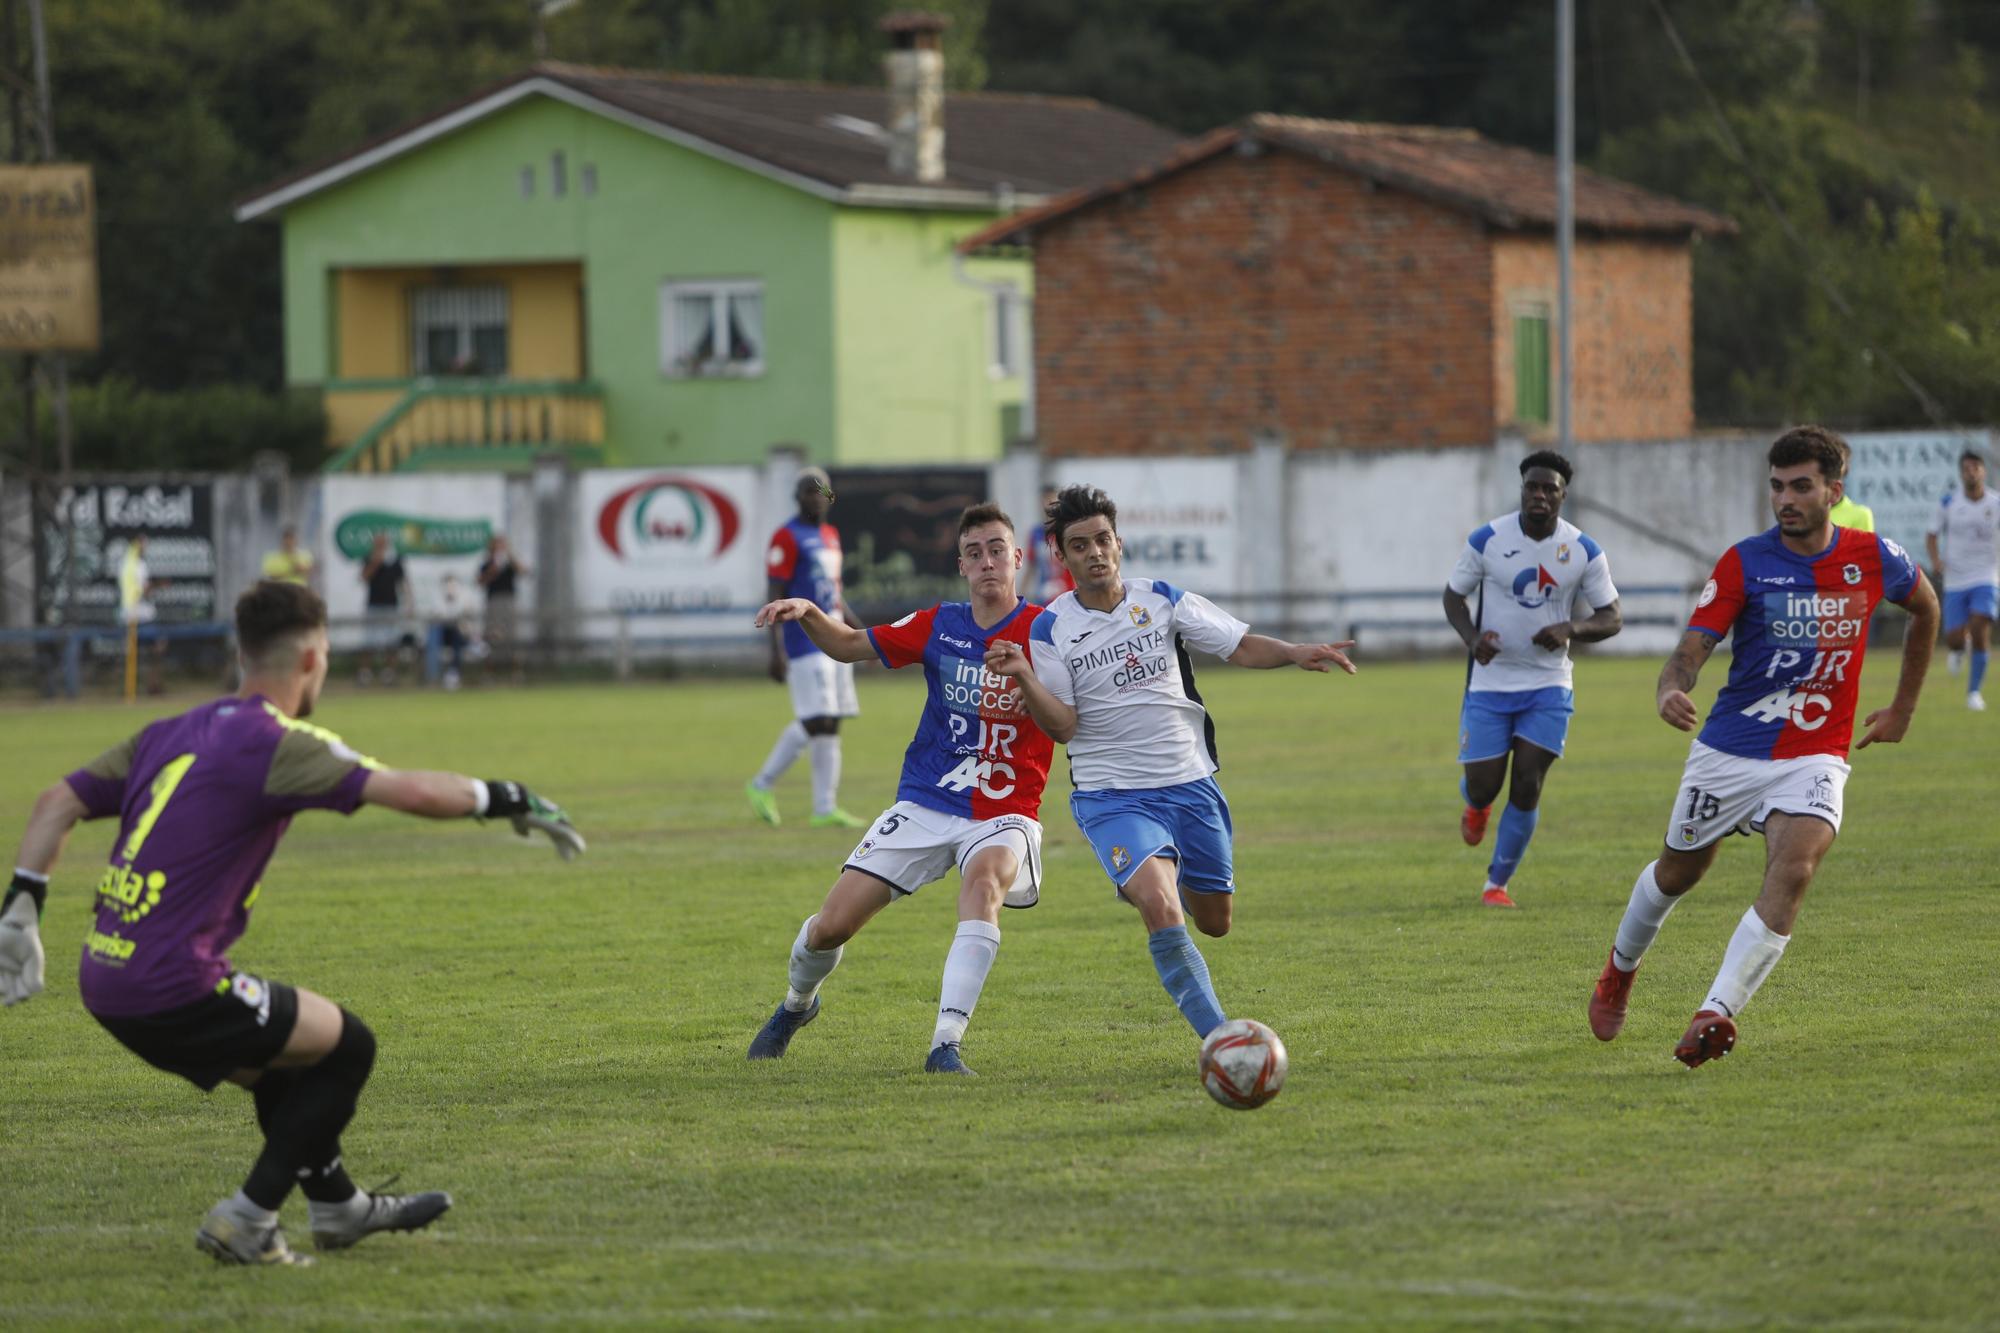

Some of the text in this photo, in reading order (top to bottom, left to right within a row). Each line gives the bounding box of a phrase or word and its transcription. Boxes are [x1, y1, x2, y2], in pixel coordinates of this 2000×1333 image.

[1787, 592, 1850, 618] inter
[1772, 619, 1862, 639] soccer
[1071, 630, 1165, 674] PIMIENTA
[1125, 652, 1140, 668] &
[1765, 649, 1853, 682] PJR
[956, 658, 1013, 690] inter
[944, 683, 1013, 711] socce
[949, 713, 1018, 758] PJR
[121, 752, 197, 861] 1
[1687, 786, 1721, 820] 15
[879, 813, 910, 836] 5
